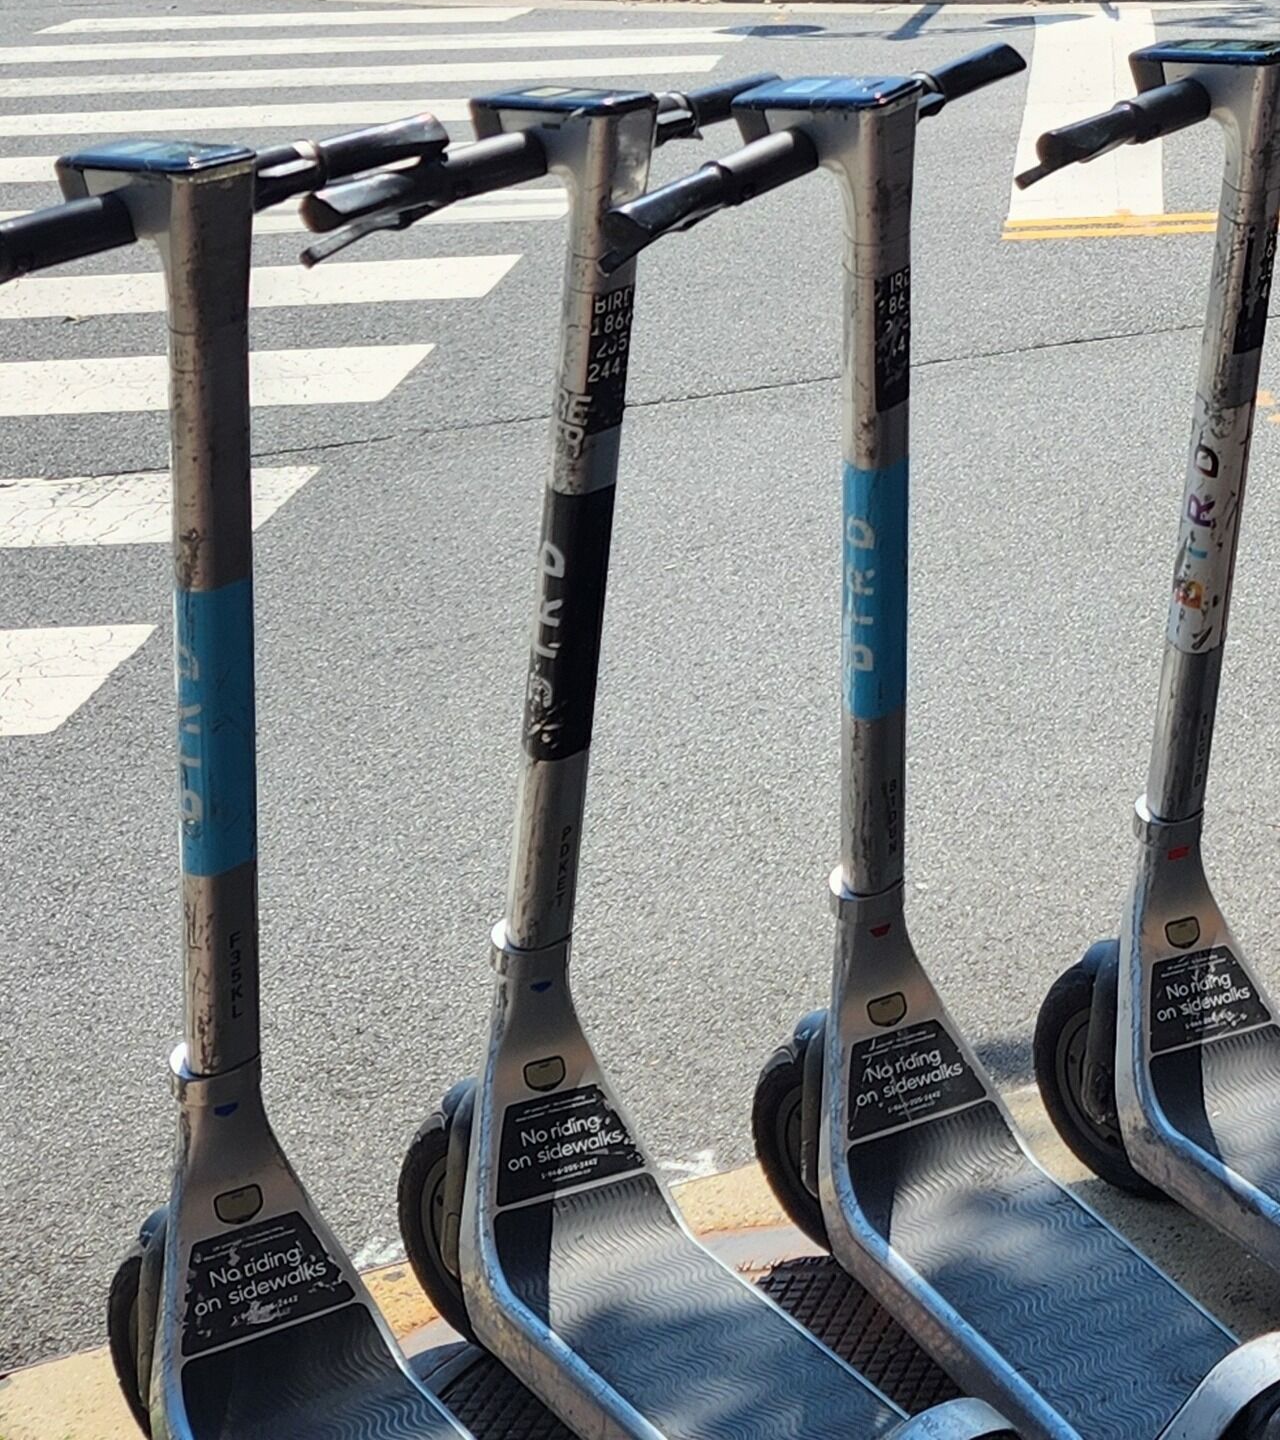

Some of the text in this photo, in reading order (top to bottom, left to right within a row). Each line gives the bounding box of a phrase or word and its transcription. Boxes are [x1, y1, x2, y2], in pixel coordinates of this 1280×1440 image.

[1156, 986, 1251, 1021] on sidewalks
[1165, 983, 1189, 1000] No
[856, 1062, 964, 1107] on sidewalks
[865, 1049, 942, 1084] No riding
[507, 1129, 624, 1172] on sidewalks
[520, 1115, 601, 1148] No riding
[208, 1246, 303, 1288] No riding
[194, 1296, 222, 1317] on
[227, 1261, 328, 1306] sidewalks
